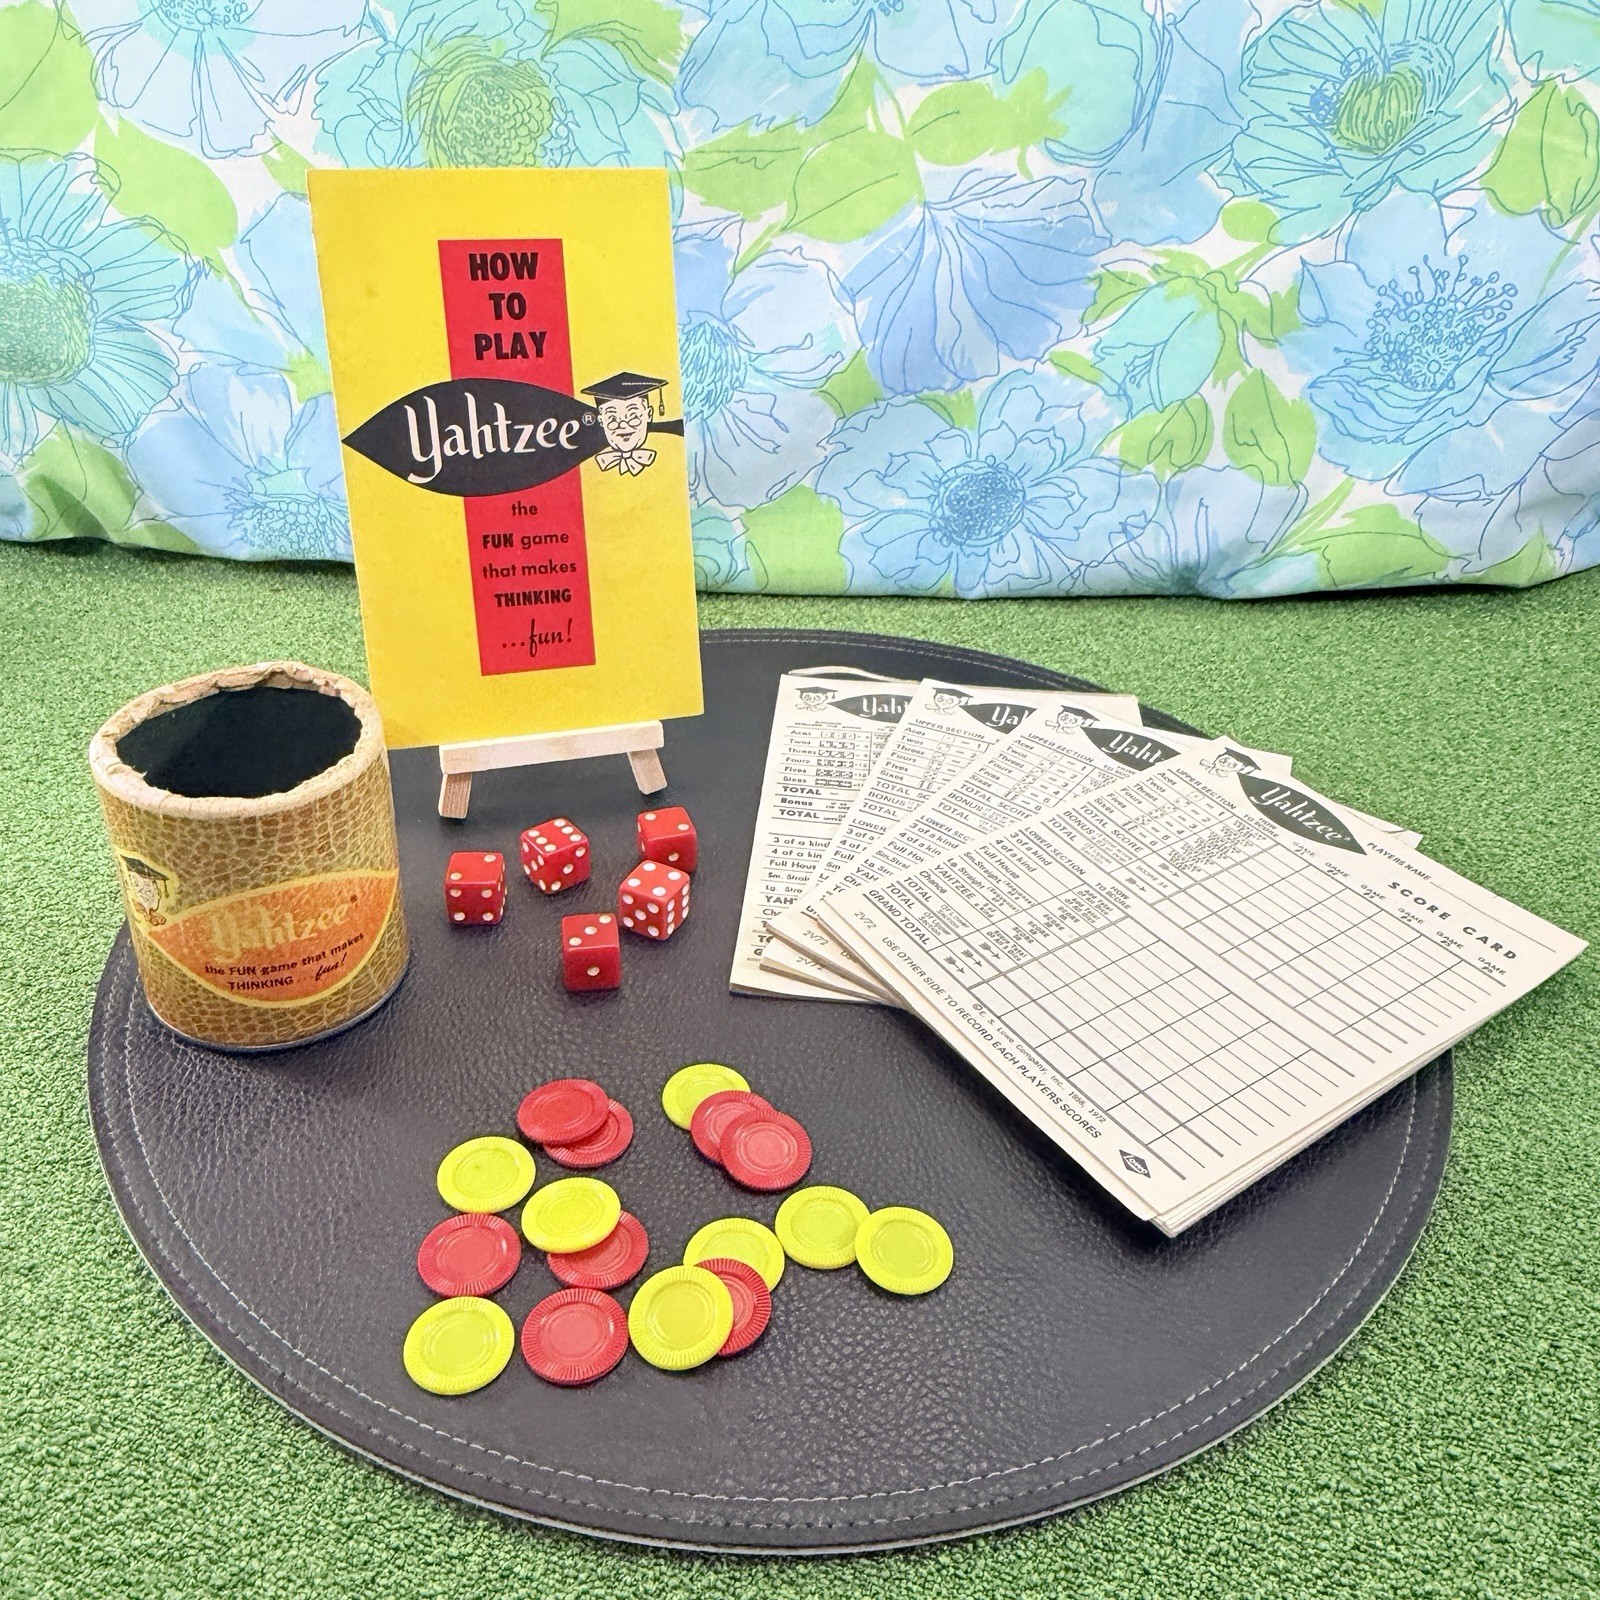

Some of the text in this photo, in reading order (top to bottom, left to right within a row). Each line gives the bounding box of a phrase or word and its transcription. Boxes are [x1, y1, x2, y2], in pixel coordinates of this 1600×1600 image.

[469, 252, 538, 281] HOW
[489, 292, 527, 320] TO
[474, 331, 547, 360] PLAY
[511, 501, 538, 516] the
[483, 533, 569, 550] FUN game
[483, 559, 577, 579] that makes
[494, 588, 572, 607] THINKING
[876, 781, 910, 795] TOTAL
[1147, 777, 1165, 792] Twos
[1158, 773, 1176, 785] Aces
[1176, 769, 1236, 809] UPPER SECTION
[782, 786, 822, 795] TOTAL
[868, 791, 905, 806] BONUS
[960, 784, 992, 803] TOTAL
[1121, 788, 1142, 804] Fours
[1134, 783, 1157, 801] Threes
[780, 798, 813, 806] Bonus
[862, 802, 898, 817] TOTAL
[938, 801, 970, 821] TOTAL
[948, 792, 984, 812] BONUS
[779, 809, 819, 819] TOTAL
[1063, 811, 1095, 834] BONUS
[918, 827, 930, 835] of
[936, 836, 959, 849] kind
[1049, 818, 1076, 841] TOTAL
[1080, 805, 1107, 828] TOTAL
[1111, 830, 1143, 852] SCORE
[808, 851, 822, 859] kin
[888, 841, 907, 853] Full
[906, 836, 919, 844] of
[926, 845, 941, 856] kin
[1025, 827, 1052, 848] LOWER
[1051, 849, 1086, 874] SECTION
[791, 862, 816, 870] Hous
[979, 846, 1019, 878] Full House
[1016, 857, 1036, 872] kind
[1032, 850, 1052, 865] kind
[1367, 842, 1431, 881] PLAYERS NAME
[904, 877, 932, 902] TOTAL
[920, 871, 947, 893] Chance
[935, 865, 976, 899] YAHTZEE
[887, 883, 914, 909] TOTAL
[869, 890, 901, 916] GRAND
[900, 917, 930, 945] TOTAL
[1388, 881, 1517, 960] SCORE CARD
[205, 933, 364, 976] the FUN game that makes
[227, 975, 294, 991] THINKING
[882, 937, 1102, 1139] USE OTHER SIDE TO RECORD EACH PLAYERS SCORES
